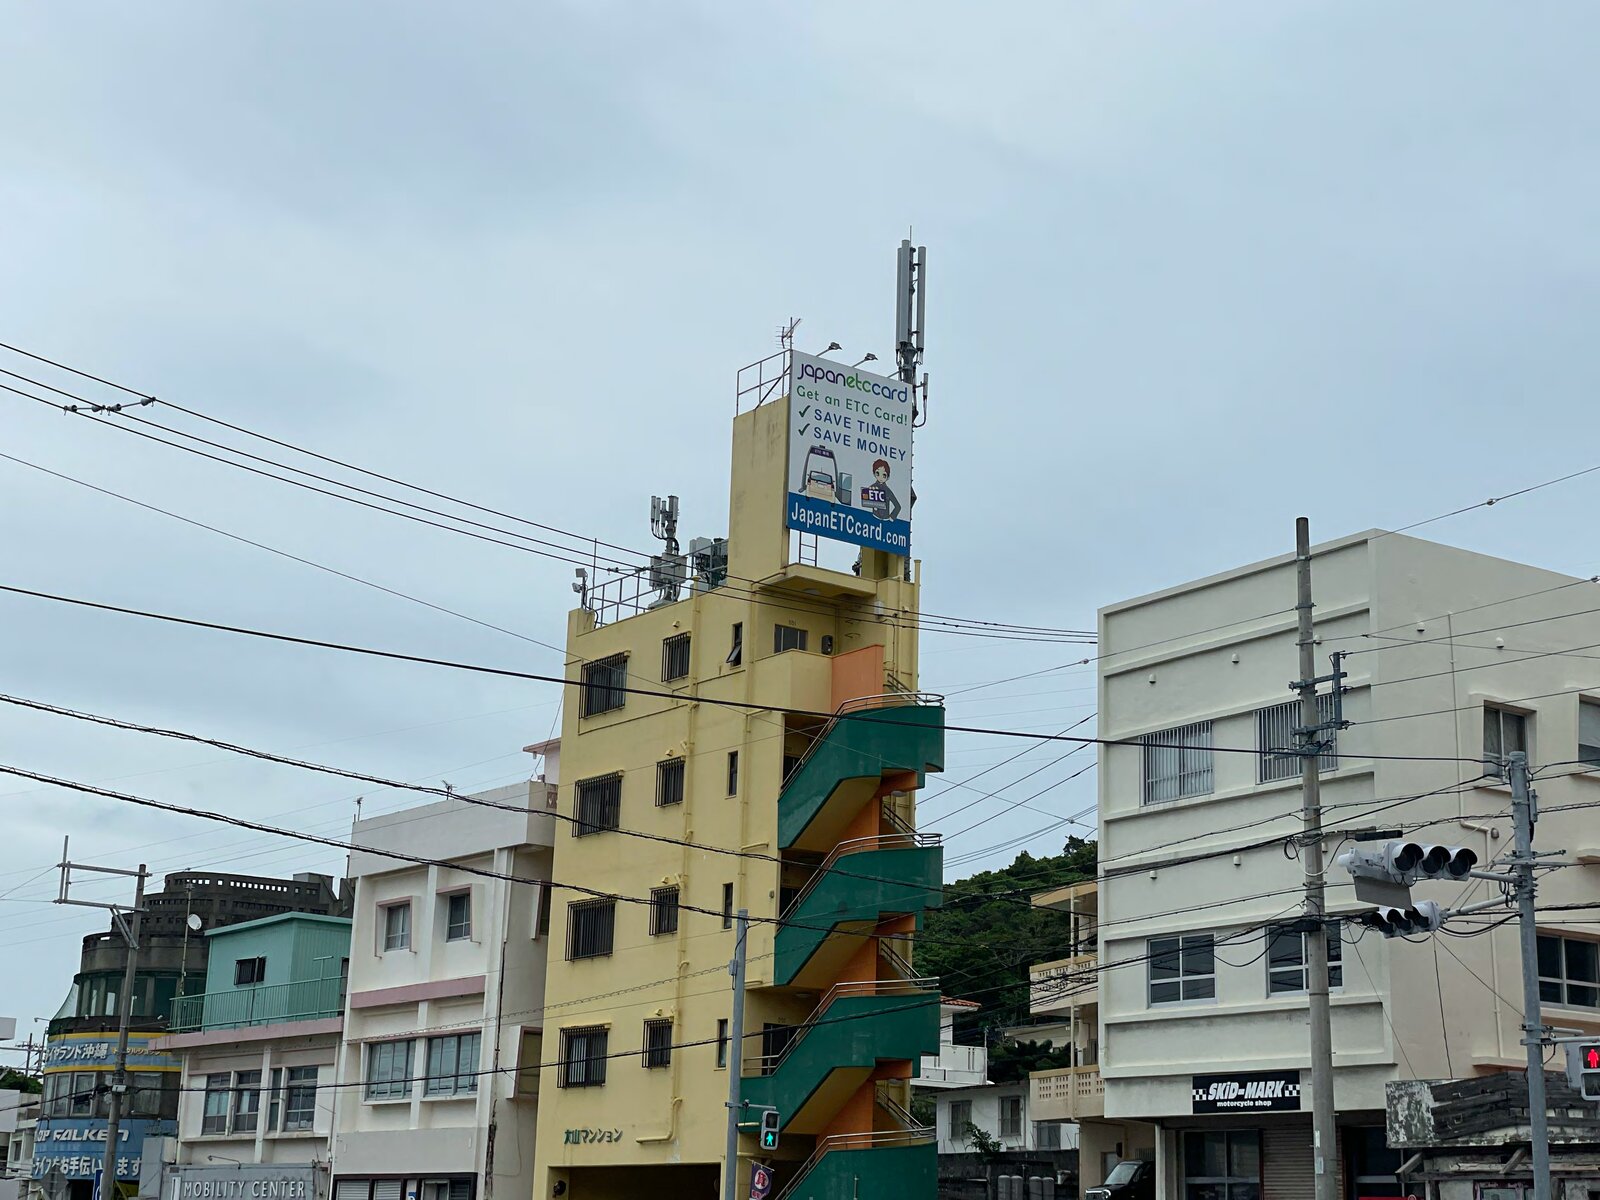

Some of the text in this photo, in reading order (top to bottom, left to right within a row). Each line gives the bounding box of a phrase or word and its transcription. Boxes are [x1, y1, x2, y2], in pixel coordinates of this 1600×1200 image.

[797, 363, 908, 403] japanetccard
[796, 385, 908, 426] Get an ETC Card!
[814, 409, 891, 440] SAVE TIME
[813, 426, 906, 461] SAVE MONEY
[868, 489, 885, 502] ETC
[791, 502, 907, 547] JapanETCcard.com
[1216, 1100, 1254, 1108] motorcycle
[564, 1128, 624, 1145] 大山マンション
[183, 1180, 306, 1198] MOBILITY CENTER
